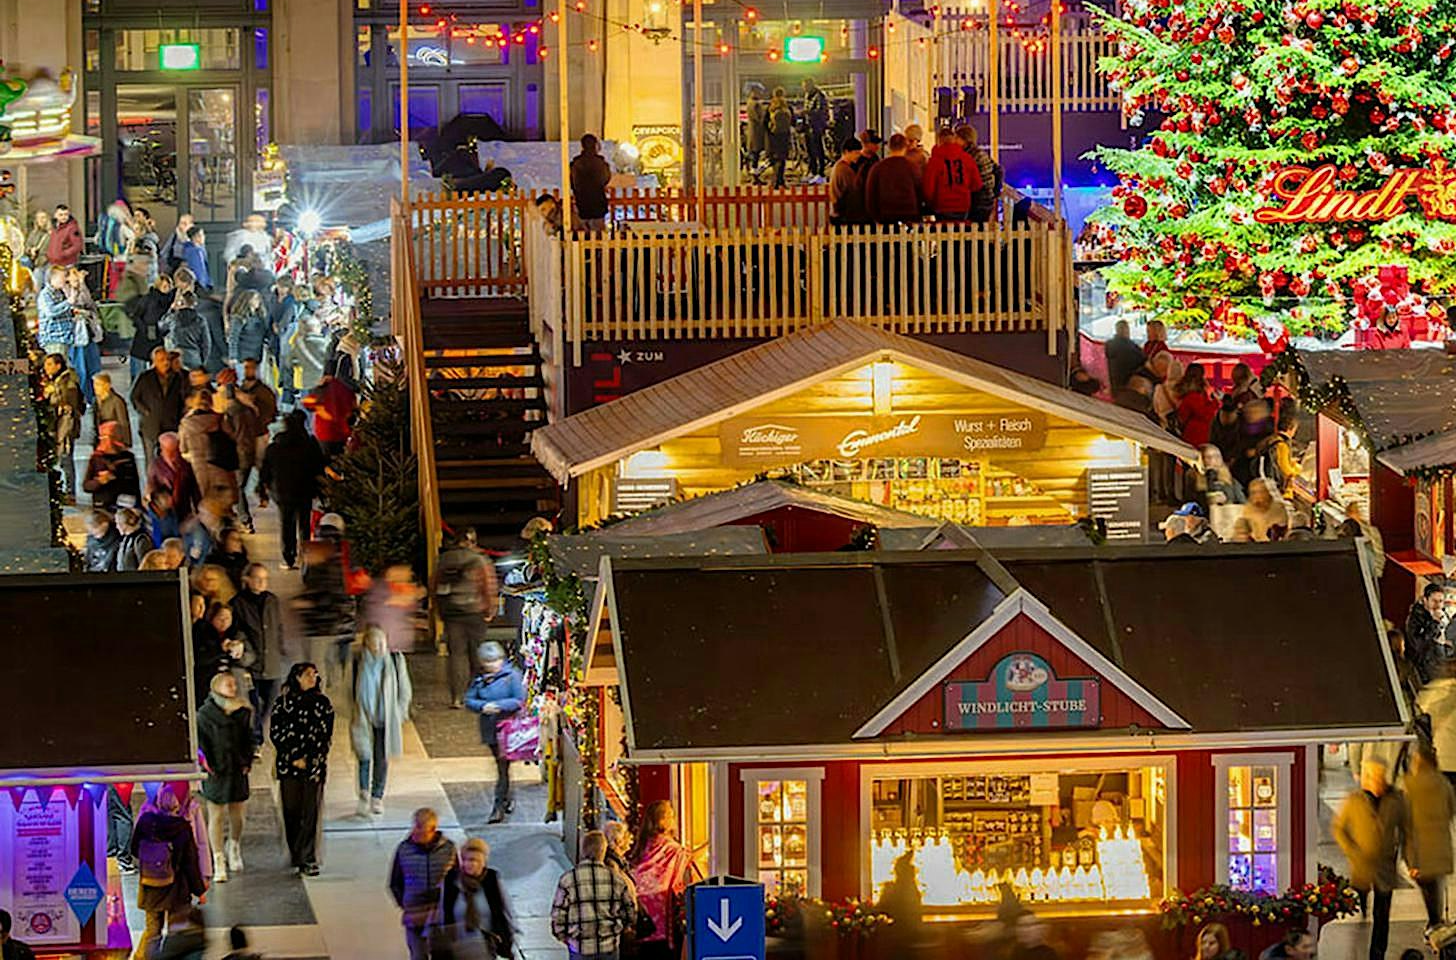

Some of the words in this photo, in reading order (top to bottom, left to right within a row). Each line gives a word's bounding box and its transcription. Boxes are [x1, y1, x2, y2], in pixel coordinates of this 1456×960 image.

[944, 158, 963, 187] 13
[1255, 163, 1421, 222] Lindt
[636, 351, 664, 361] ZUM
[954, 419, 984, 432] Wurst
[999, 418, 1032, 432] Fleisch
[963, 435, 1022, 451] Spezialitäten
[958, 699, 1087, 714] WINDLICHT-STUBE
